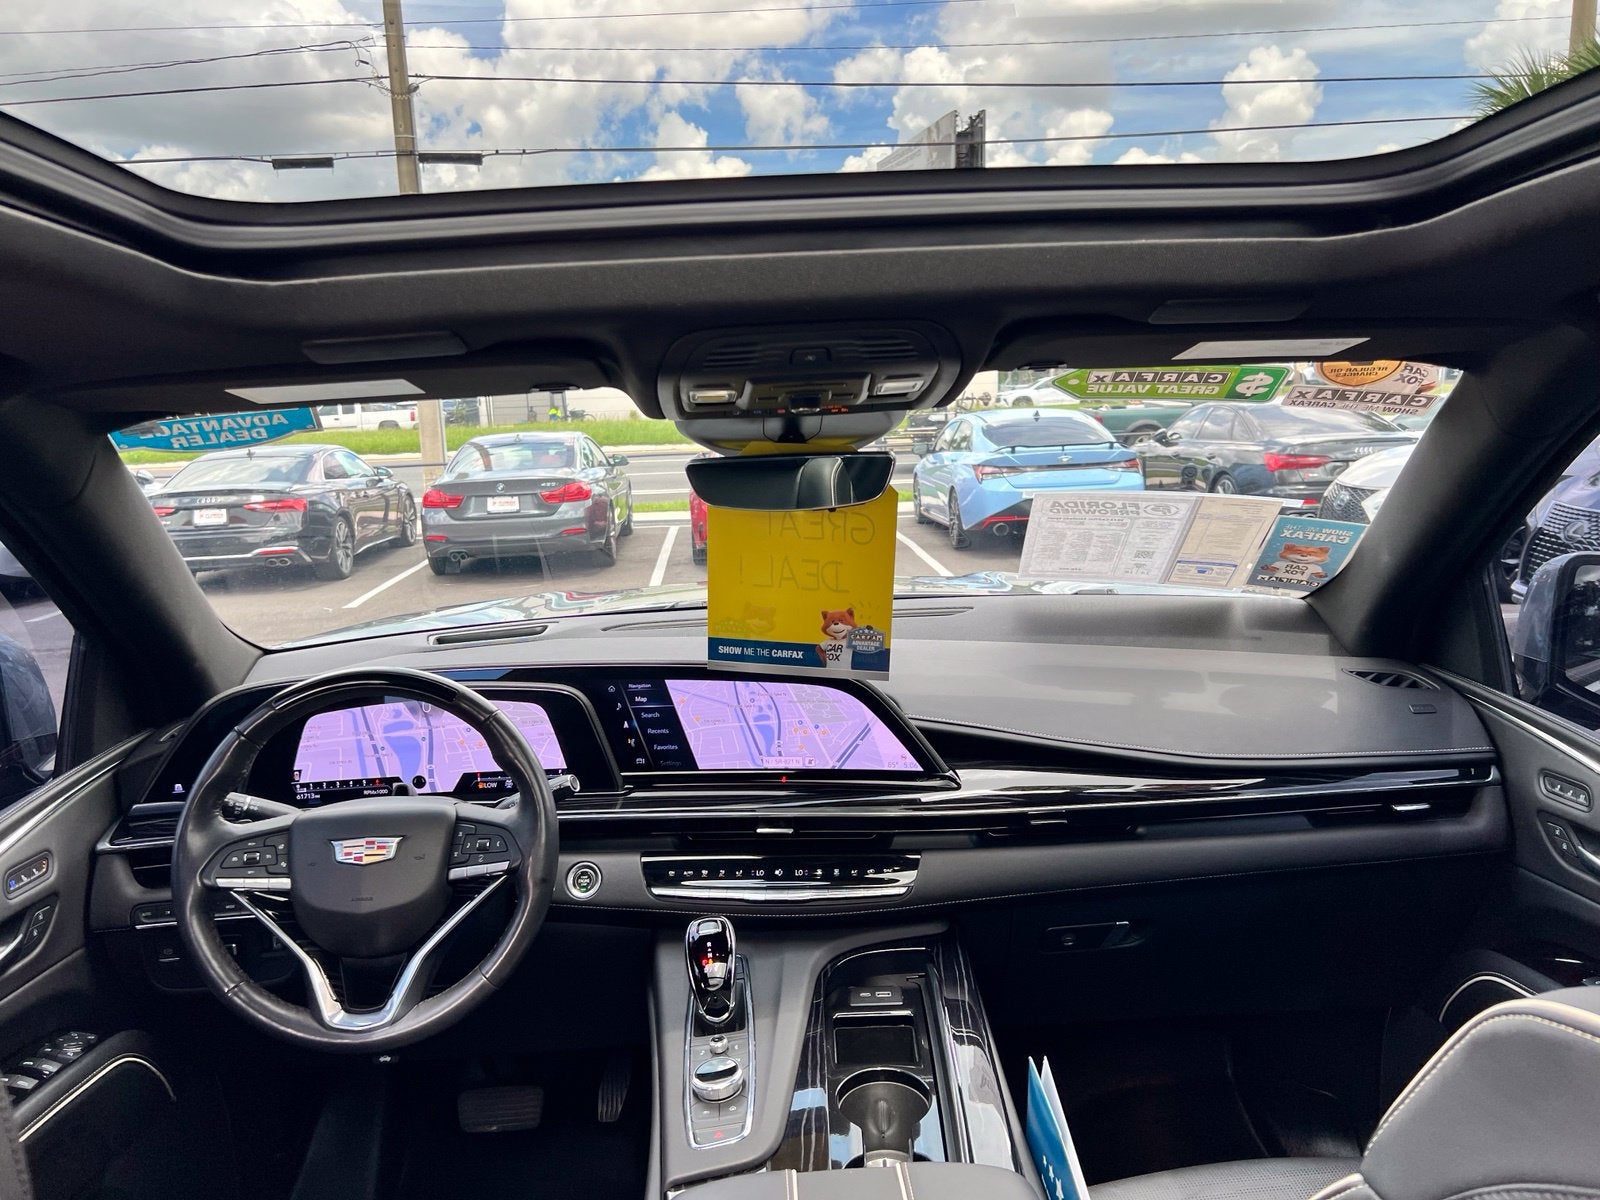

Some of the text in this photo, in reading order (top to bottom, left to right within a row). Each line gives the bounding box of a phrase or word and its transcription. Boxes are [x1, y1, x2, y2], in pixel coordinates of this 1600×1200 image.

[850, 633, 882, 641] CARFAX
[718, 645, 804, 659] SHOW ME THE CARFAX
[826, 643, 843, 653] CAR
[756, 869, 765, 877] LO
[795, 869, 804, 877] LO
